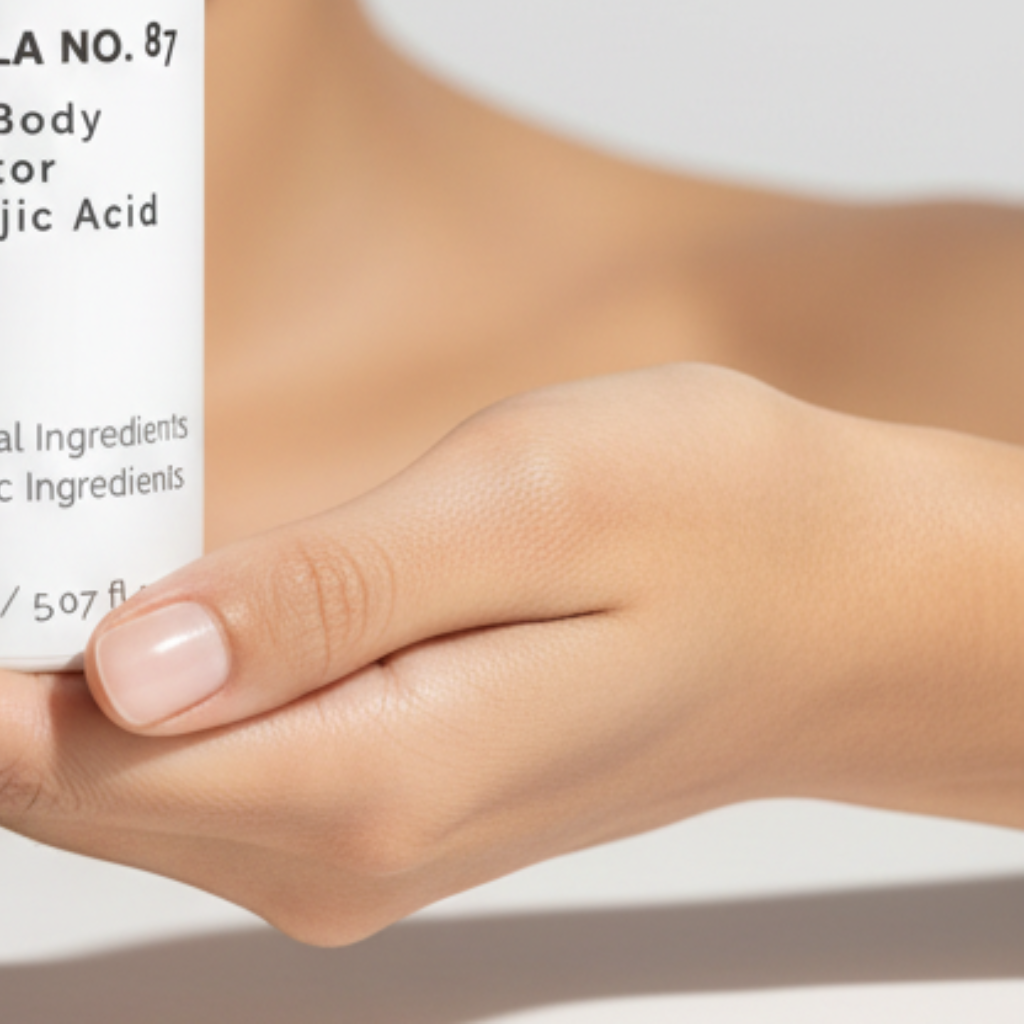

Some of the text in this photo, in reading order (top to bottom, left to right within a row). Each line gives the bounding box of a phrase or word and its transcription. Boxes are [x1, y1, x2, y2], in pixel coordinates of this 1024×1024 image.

[60, 29, 133, 64] NO.
[144, 21, 177, 67] 87
[73, 192, 157, 231] Acid
[0, 584, 21, 619] /
